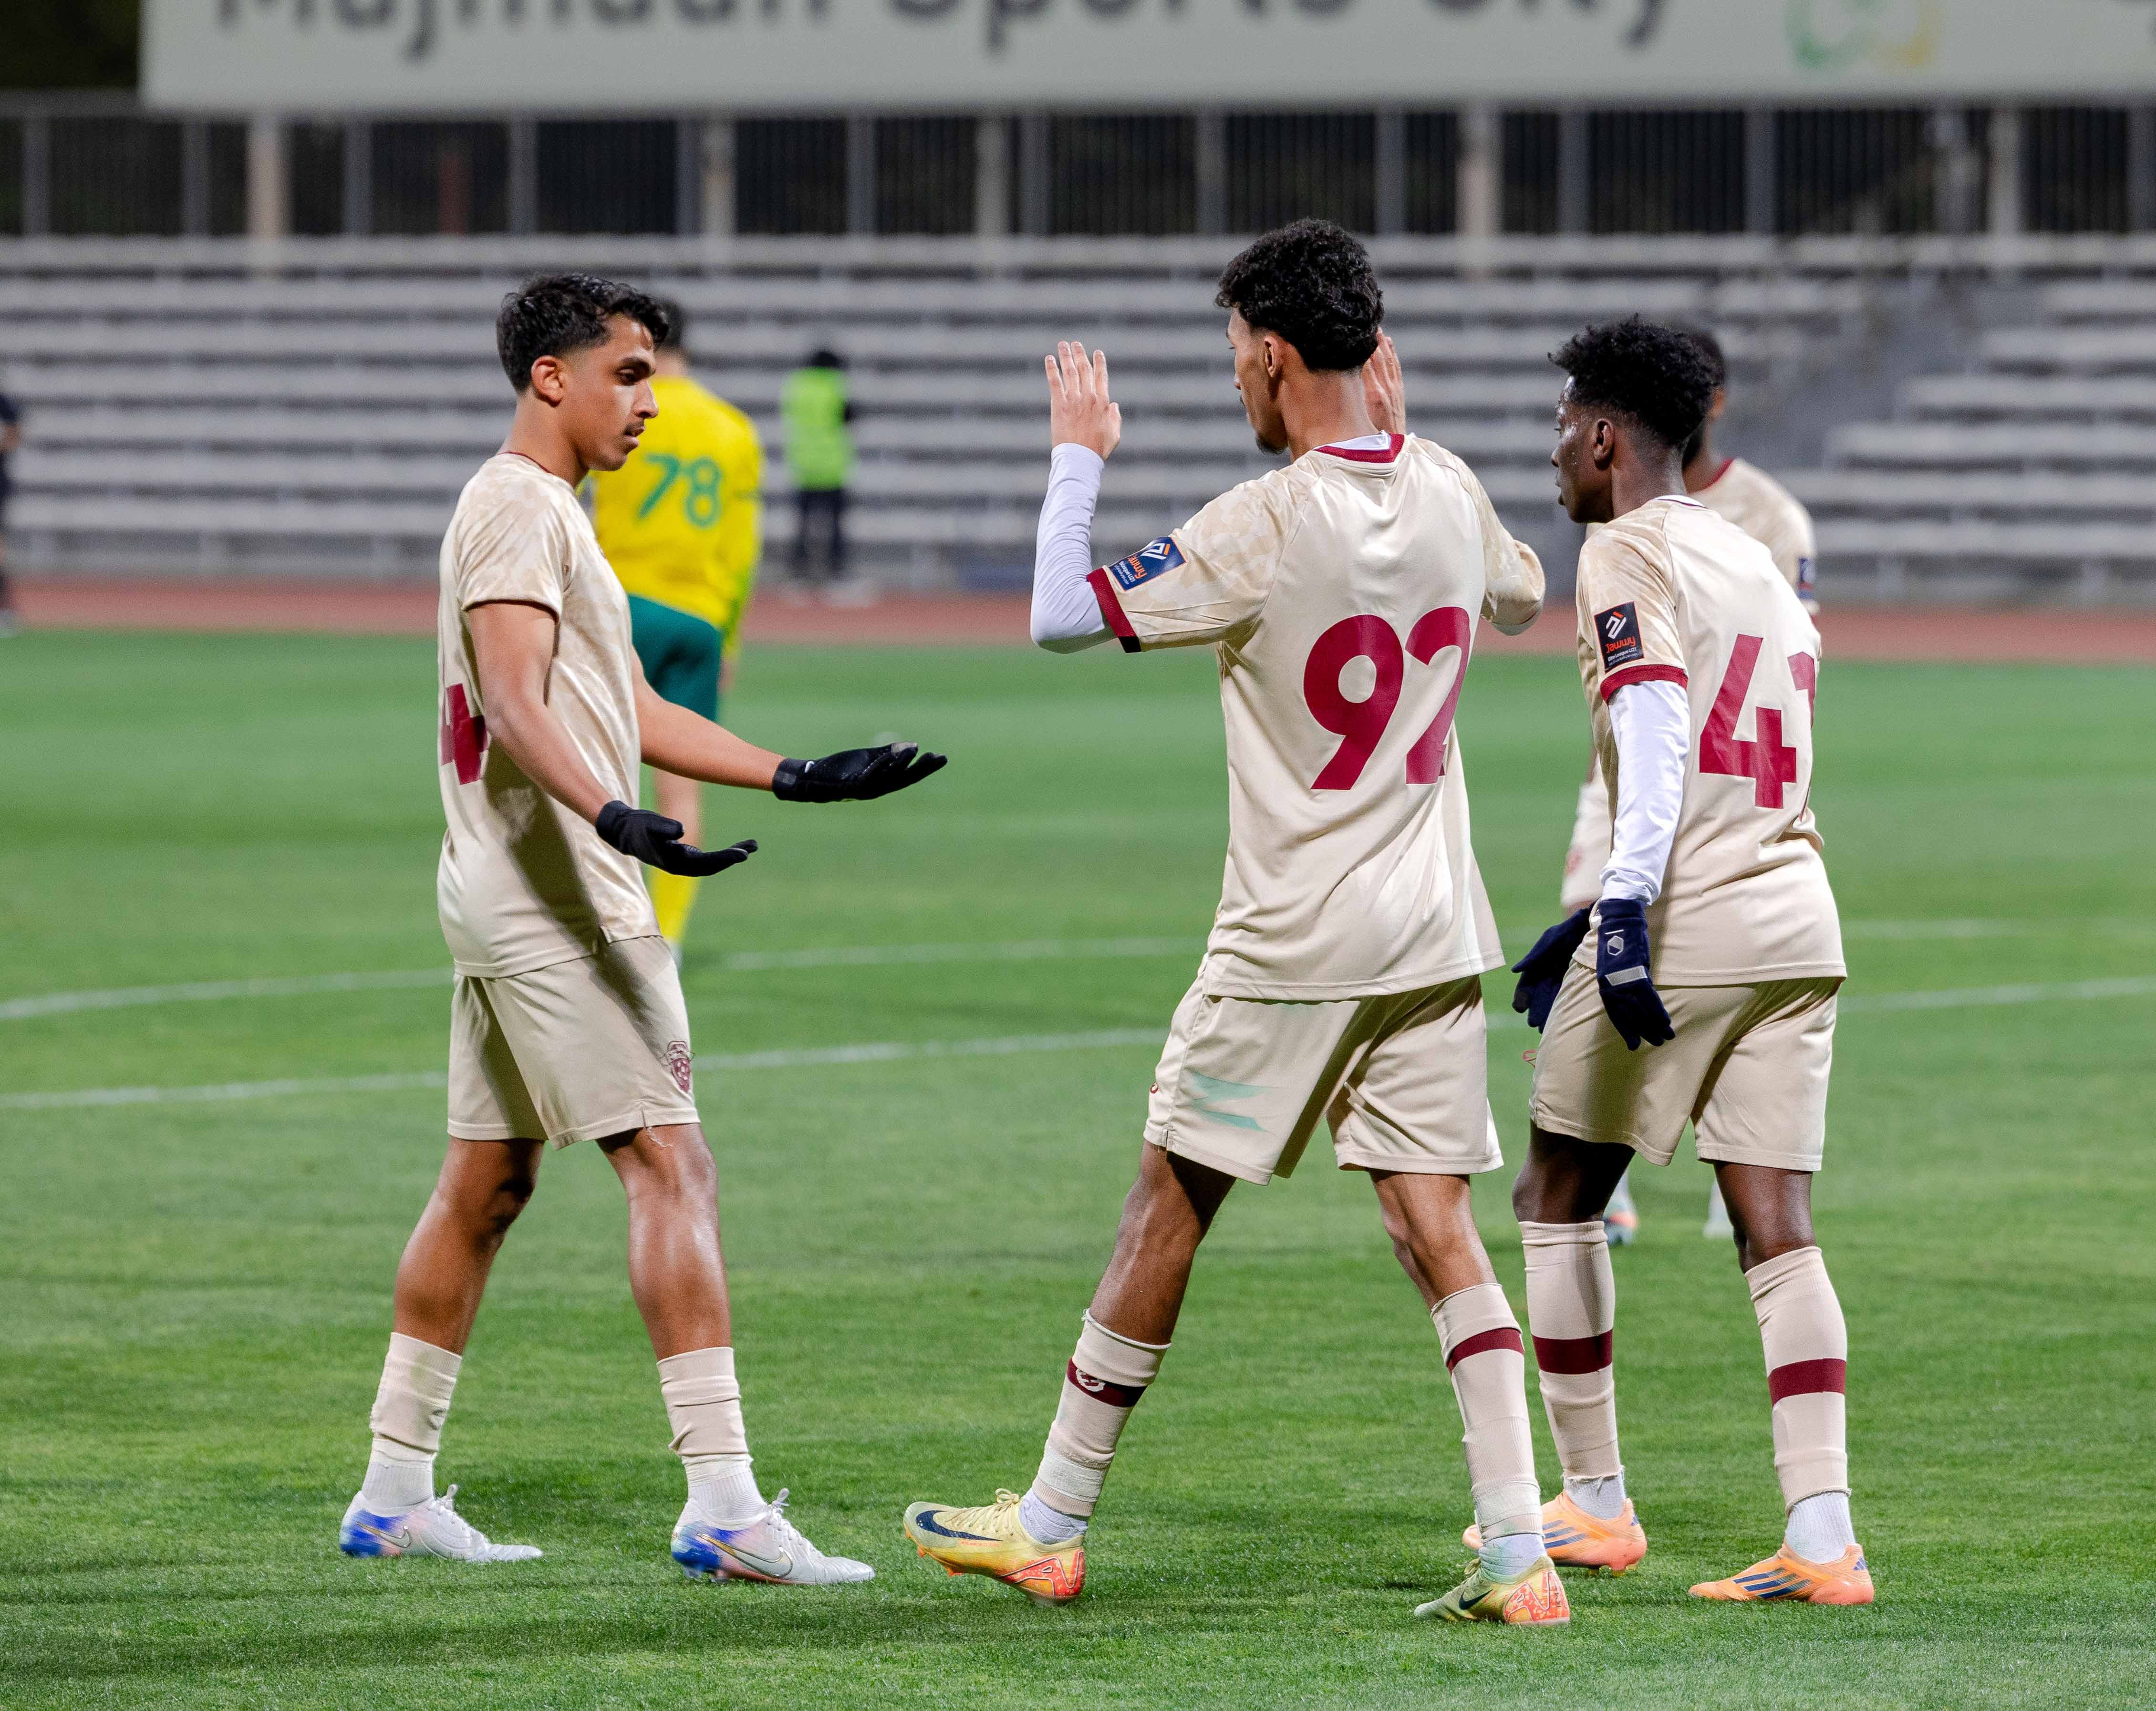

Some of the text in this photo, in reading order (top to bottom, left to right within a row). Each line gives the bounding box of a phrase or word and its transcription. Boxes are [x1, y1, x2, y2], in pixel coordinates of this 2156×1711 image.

[636, 453, 723, 529] 78
[1127, 554, 1148, 579] awwy
[1303, 606, 1471, 790] 92
